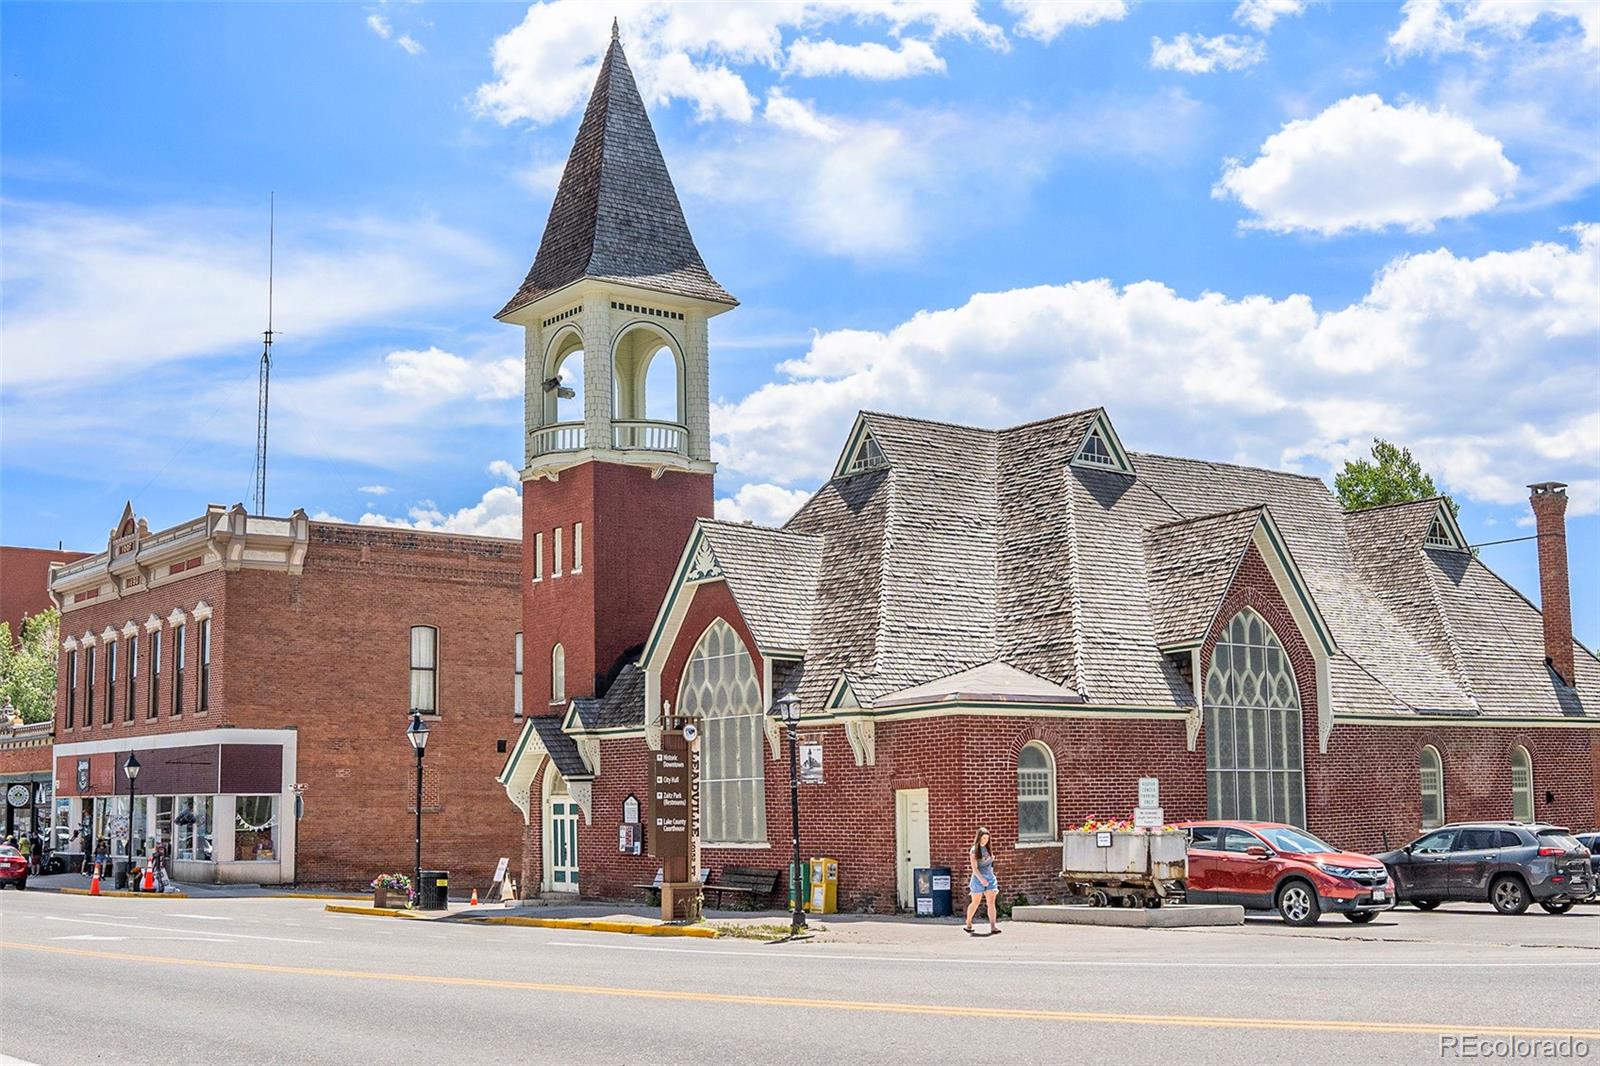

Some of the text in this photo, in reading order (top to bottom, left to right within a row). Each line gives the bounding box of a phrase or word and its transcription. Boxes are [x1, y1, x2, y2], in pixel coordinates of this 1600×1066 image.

[663, 776, 671, 784] City
[691, 750, 700, 837] LEADVILLE
[663, 817, 687, 826] Lake County
